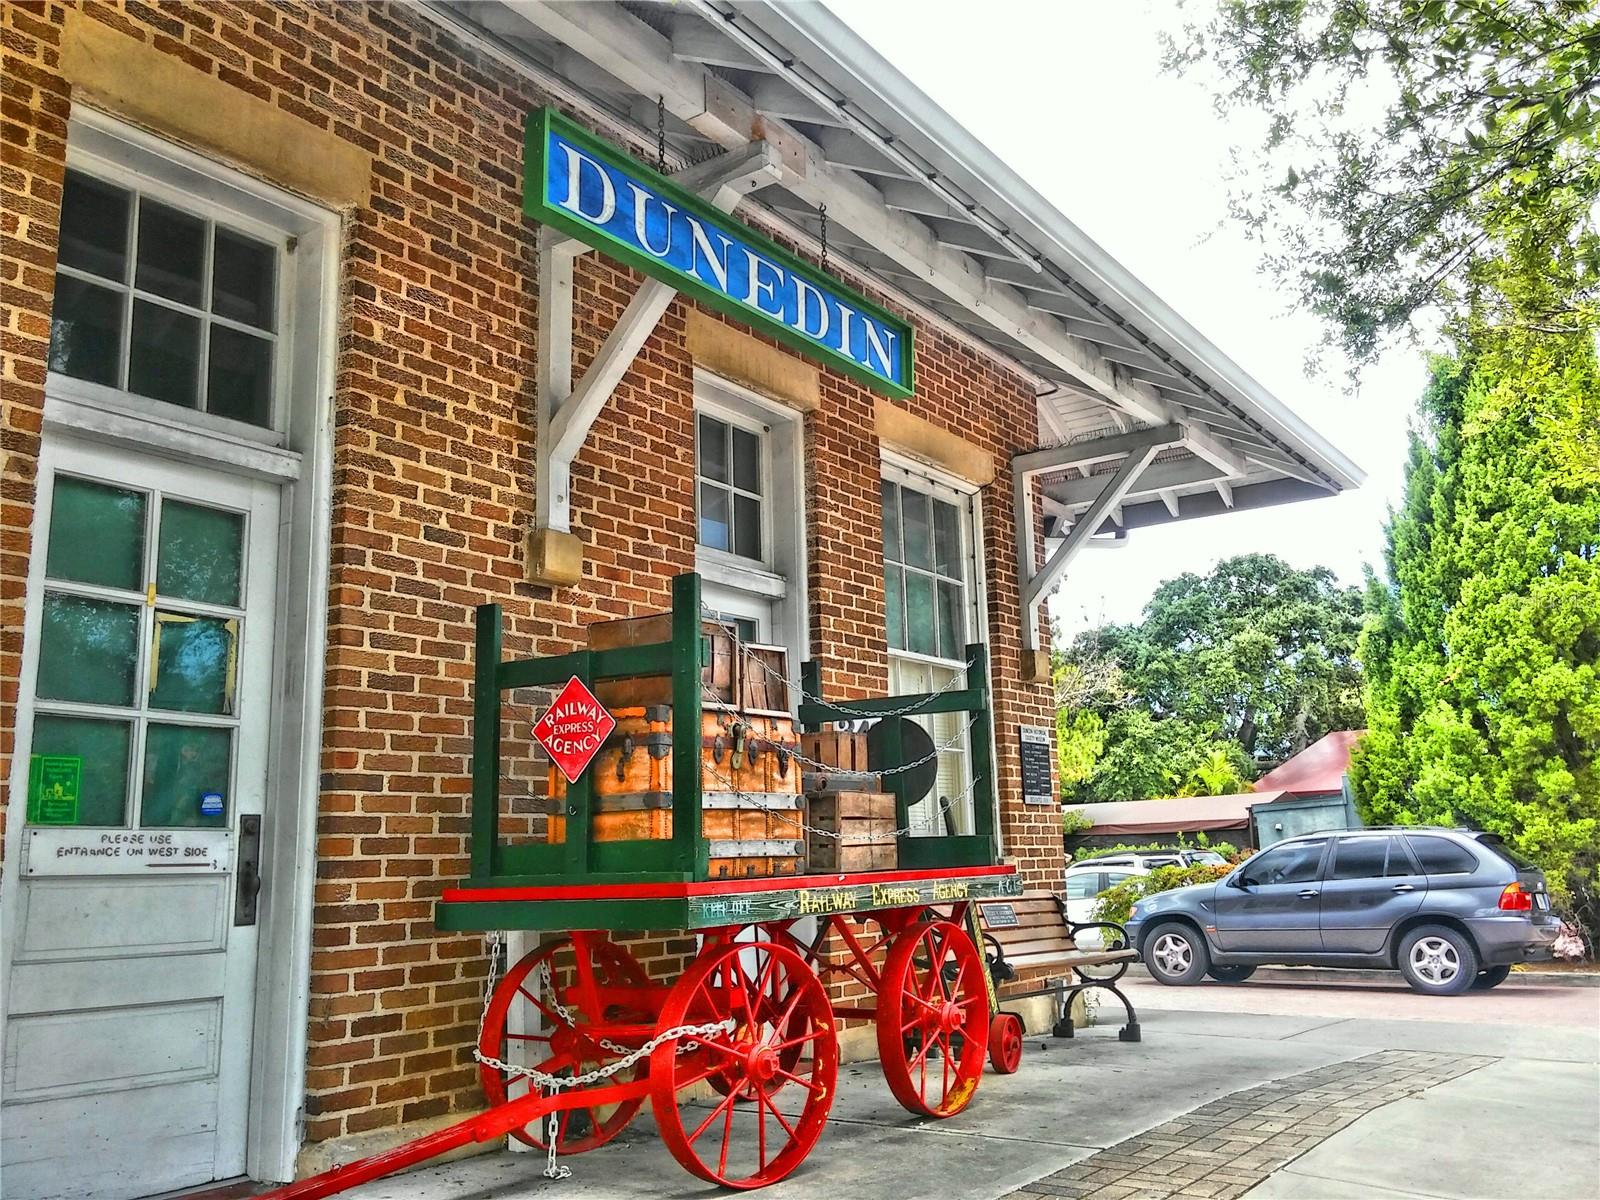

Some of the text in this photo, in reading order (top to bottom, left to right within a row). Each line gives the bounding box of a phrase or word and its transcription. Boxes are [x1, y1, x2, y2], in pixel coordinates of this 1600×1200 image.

[558, 141, 896, 379] DUNEDIN
[545, 702, 606, 728] RAILWAY
[553, 721, 594, 735] EXPRESS
[543, 728, 602, 754] AGENCY
[100, 834, 173, 845] PLEASE USE
[56, 846, 121, 858] ENTRANCE
[126, 847, 143, 857] ON
[149, 847, 179, 857] WEST
[732, 899, 751, 916] OFF
[799, 880, 969, 914] RAILWAY EXPRESS AGENCY
